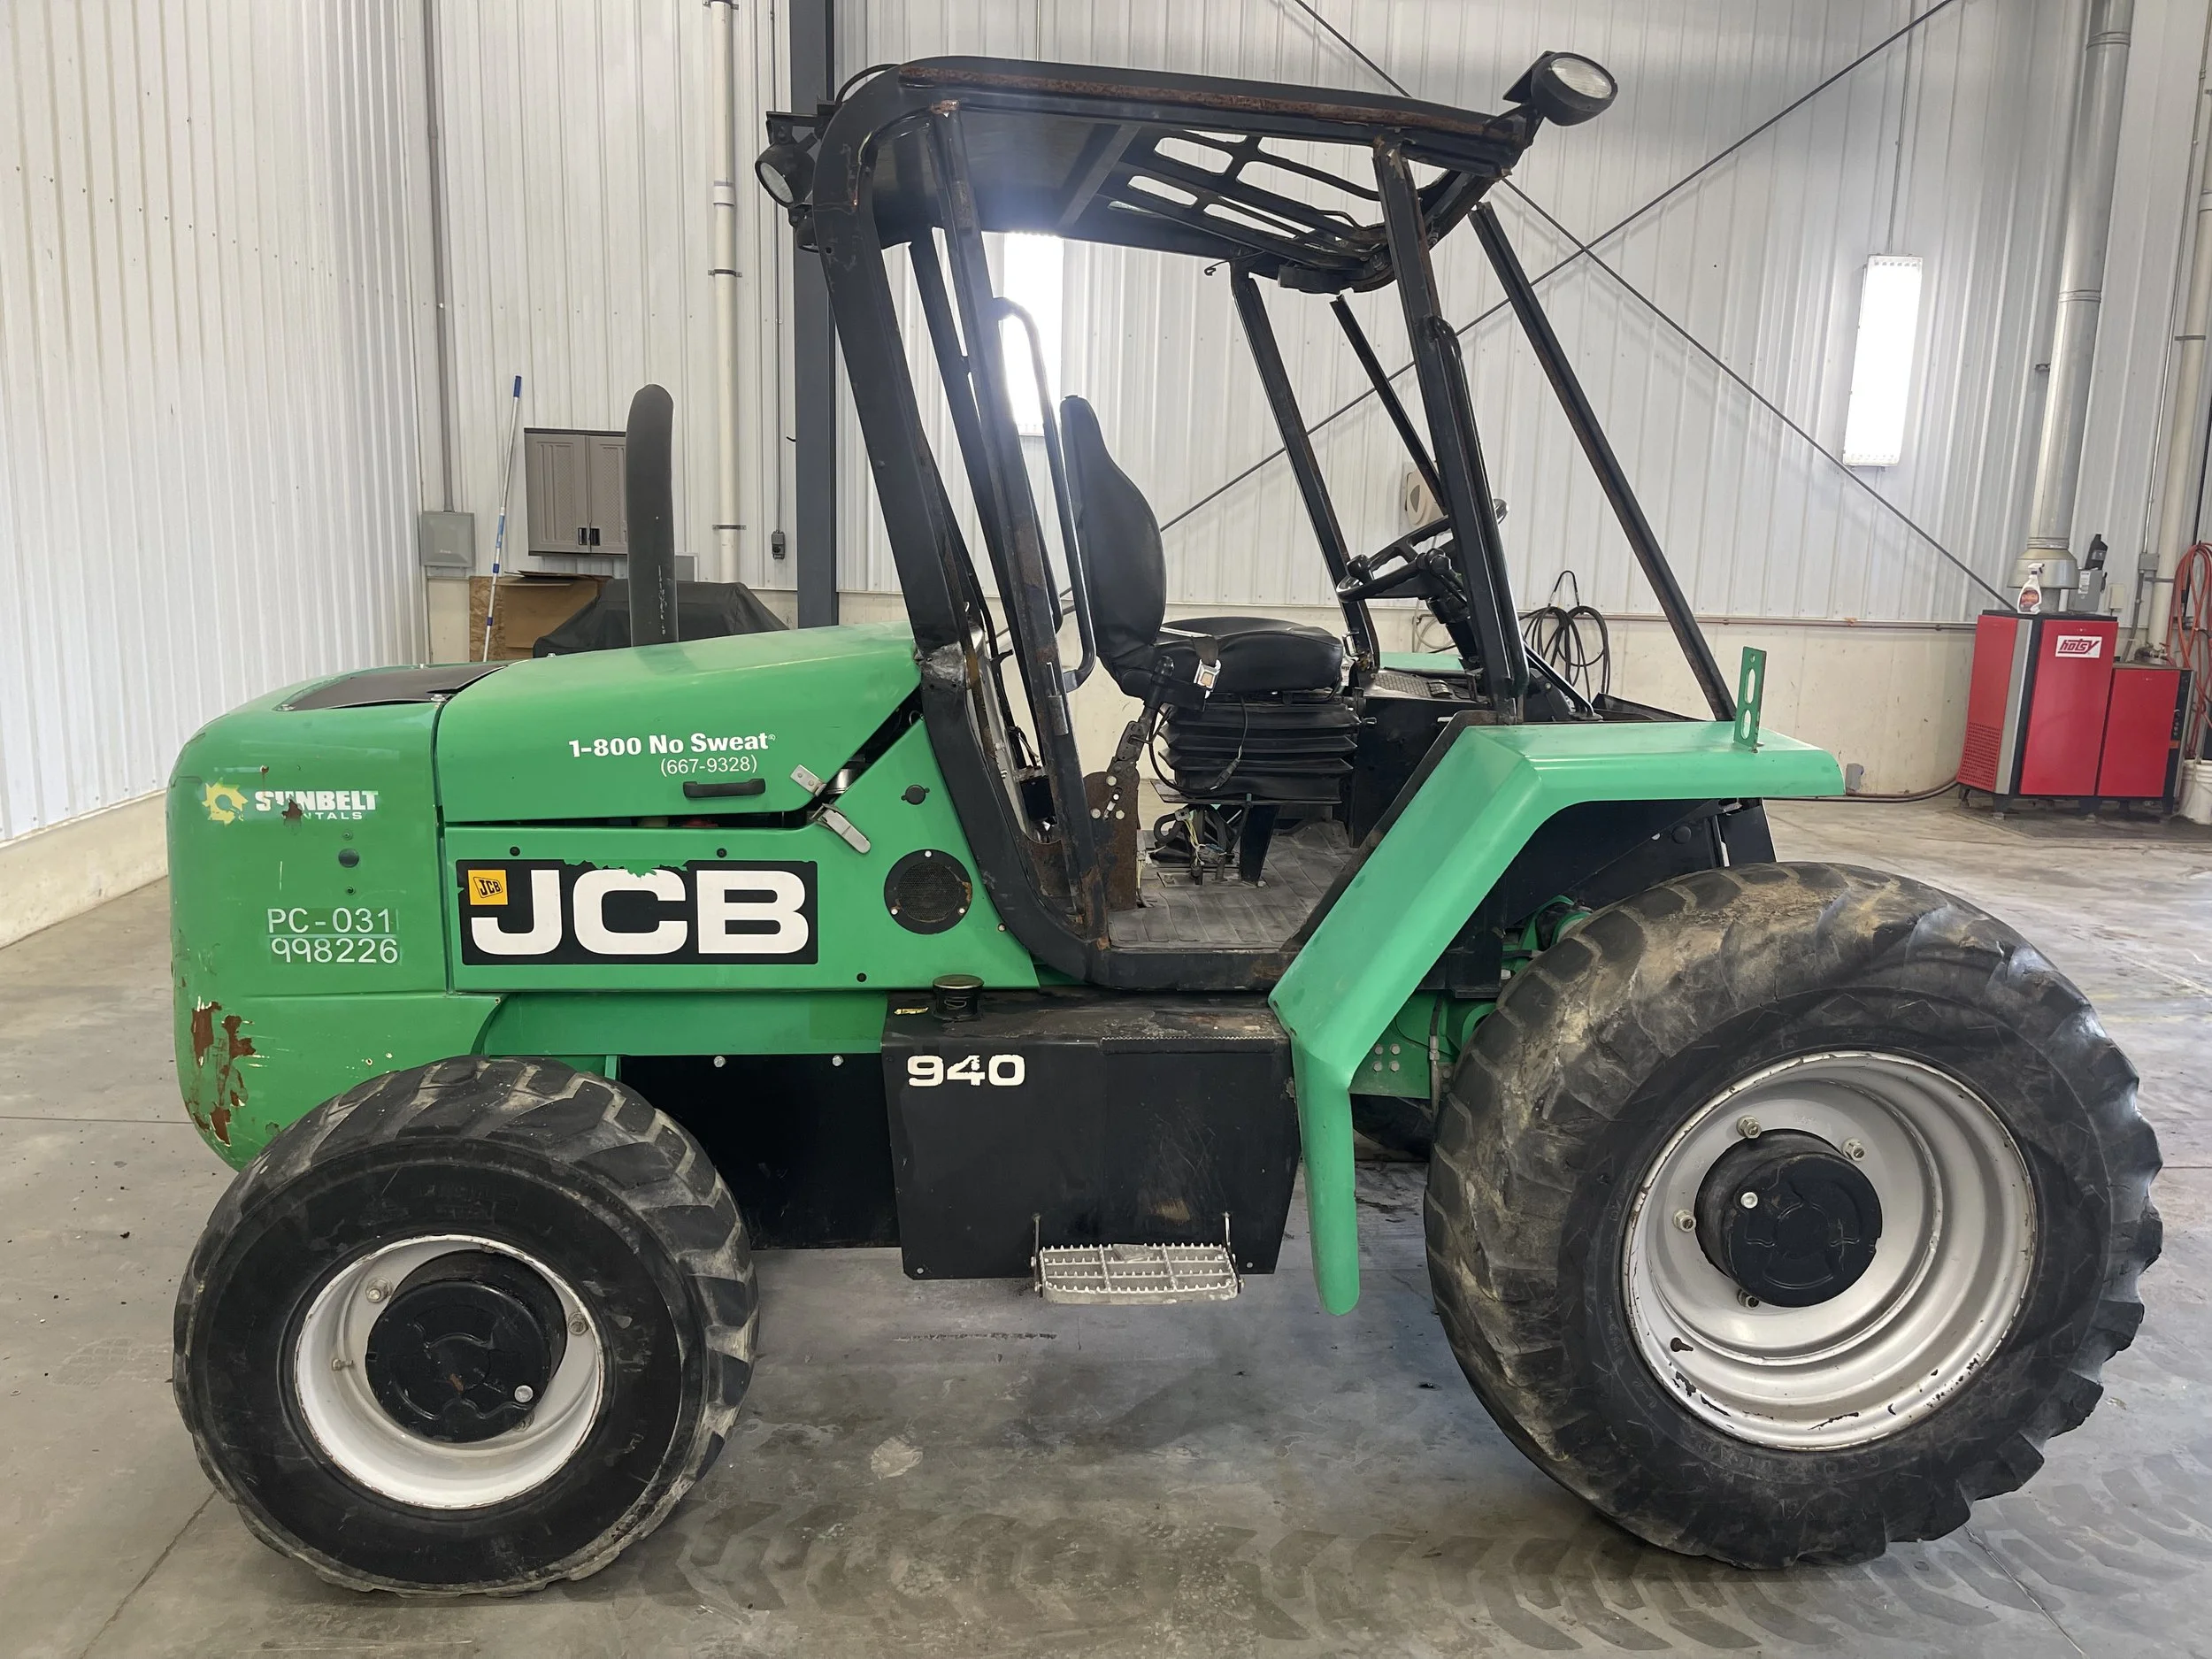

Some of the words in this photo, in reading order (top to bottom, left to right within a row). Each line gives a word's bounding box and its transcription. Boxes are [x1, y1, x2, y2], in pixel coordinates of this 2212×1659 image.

[568, 737, 642, 757] 1-800
[649, 734, 684, 754] No
[660, 754, 757, 777] (667-9328)
[479, 879, 501, 895] JCB
[267, 908, 390, 933] PC-031
[470, 869, 810, 955] JCB
[271, 938, 398, 964] 998226
[907, 1054, 1026, 1087] 940
